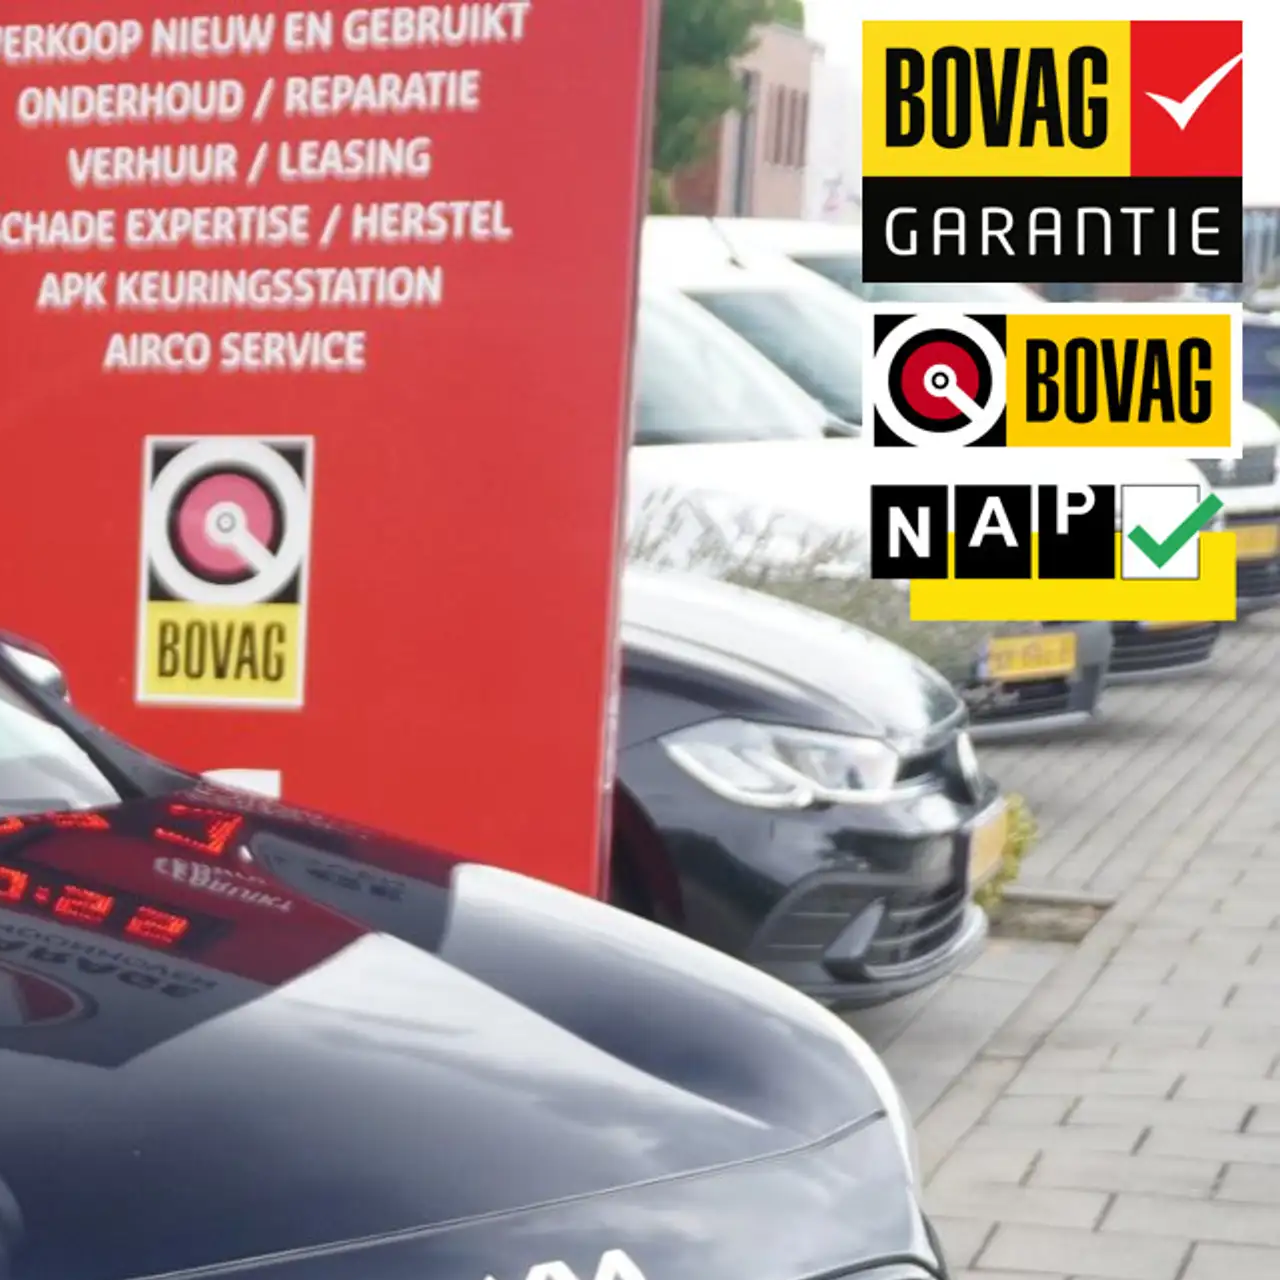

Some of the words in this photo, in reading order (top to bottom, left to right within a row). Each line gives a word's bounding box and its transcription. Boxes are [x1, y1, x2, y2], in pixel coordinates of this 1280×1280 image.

[151, 12, 276, 57] NIEUW
[283, 10, 334, 52] EN
[342, 0, 532, 49] GEBRUIKT
[18, 80, 244, 125] ONDERHOUD
[253, 78, 275, 121] /
[285, 70, 480, 116] REPARATIE
[67, 143, 238, 188] VERHUUR
[246, 142, 269, 185] /
[278, 137, 432, 181] LEASING
[125, 205, 311, 248] EXPERTISE
[320, 204, 342, 248] /
[351, 200, 513, 242] HERSTEL
[36, 271, 107, 308] APK
[116, 266, 443, 309] KEURINGSSTATION
[102, 332, 212, 370] AIRCO
[220, 331, 366, 371] SERVICE
[158, 621, 286, 682] BOVAG
